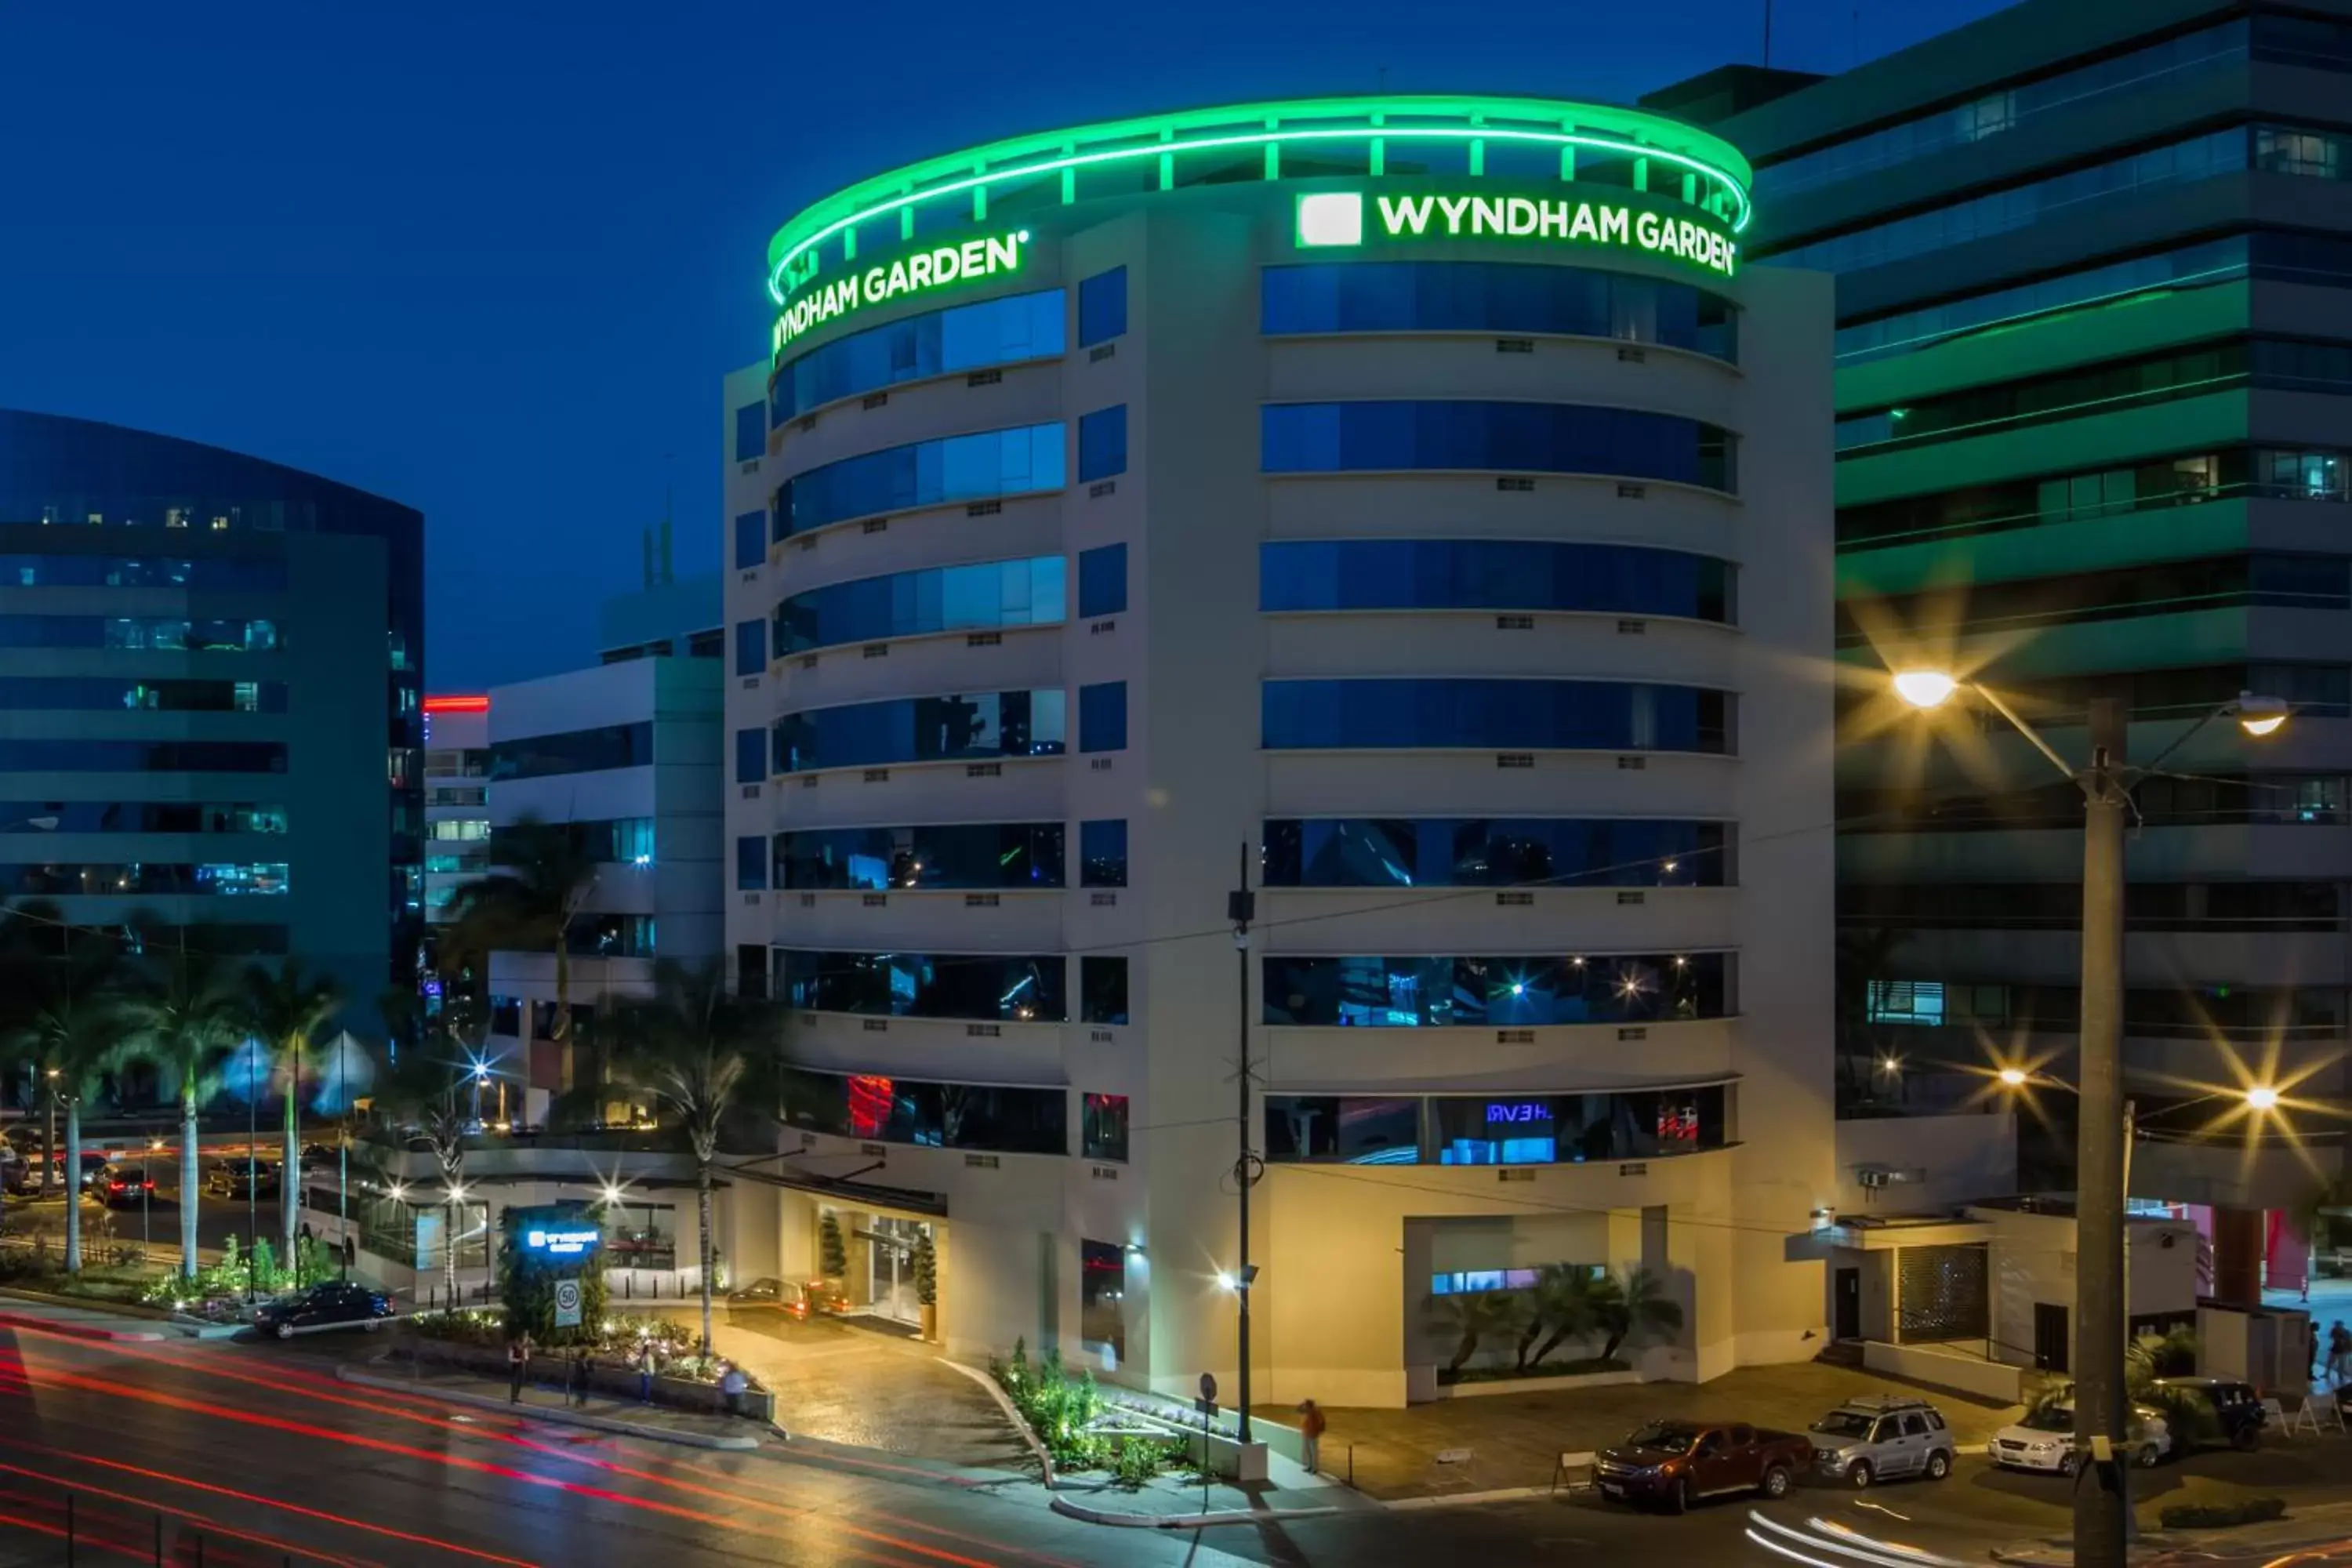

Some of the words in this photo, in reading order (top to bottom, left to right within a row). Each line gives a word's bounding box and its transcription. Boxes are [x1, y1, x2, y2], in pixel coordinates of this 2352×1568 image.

[864, 233, 1018, 303] GARDEN
[1377, 196, 1629, 245] WYNDHAM
[1635, 212, 1733, 276] GARDEN
[562, 1290, 575, 1303] 50
